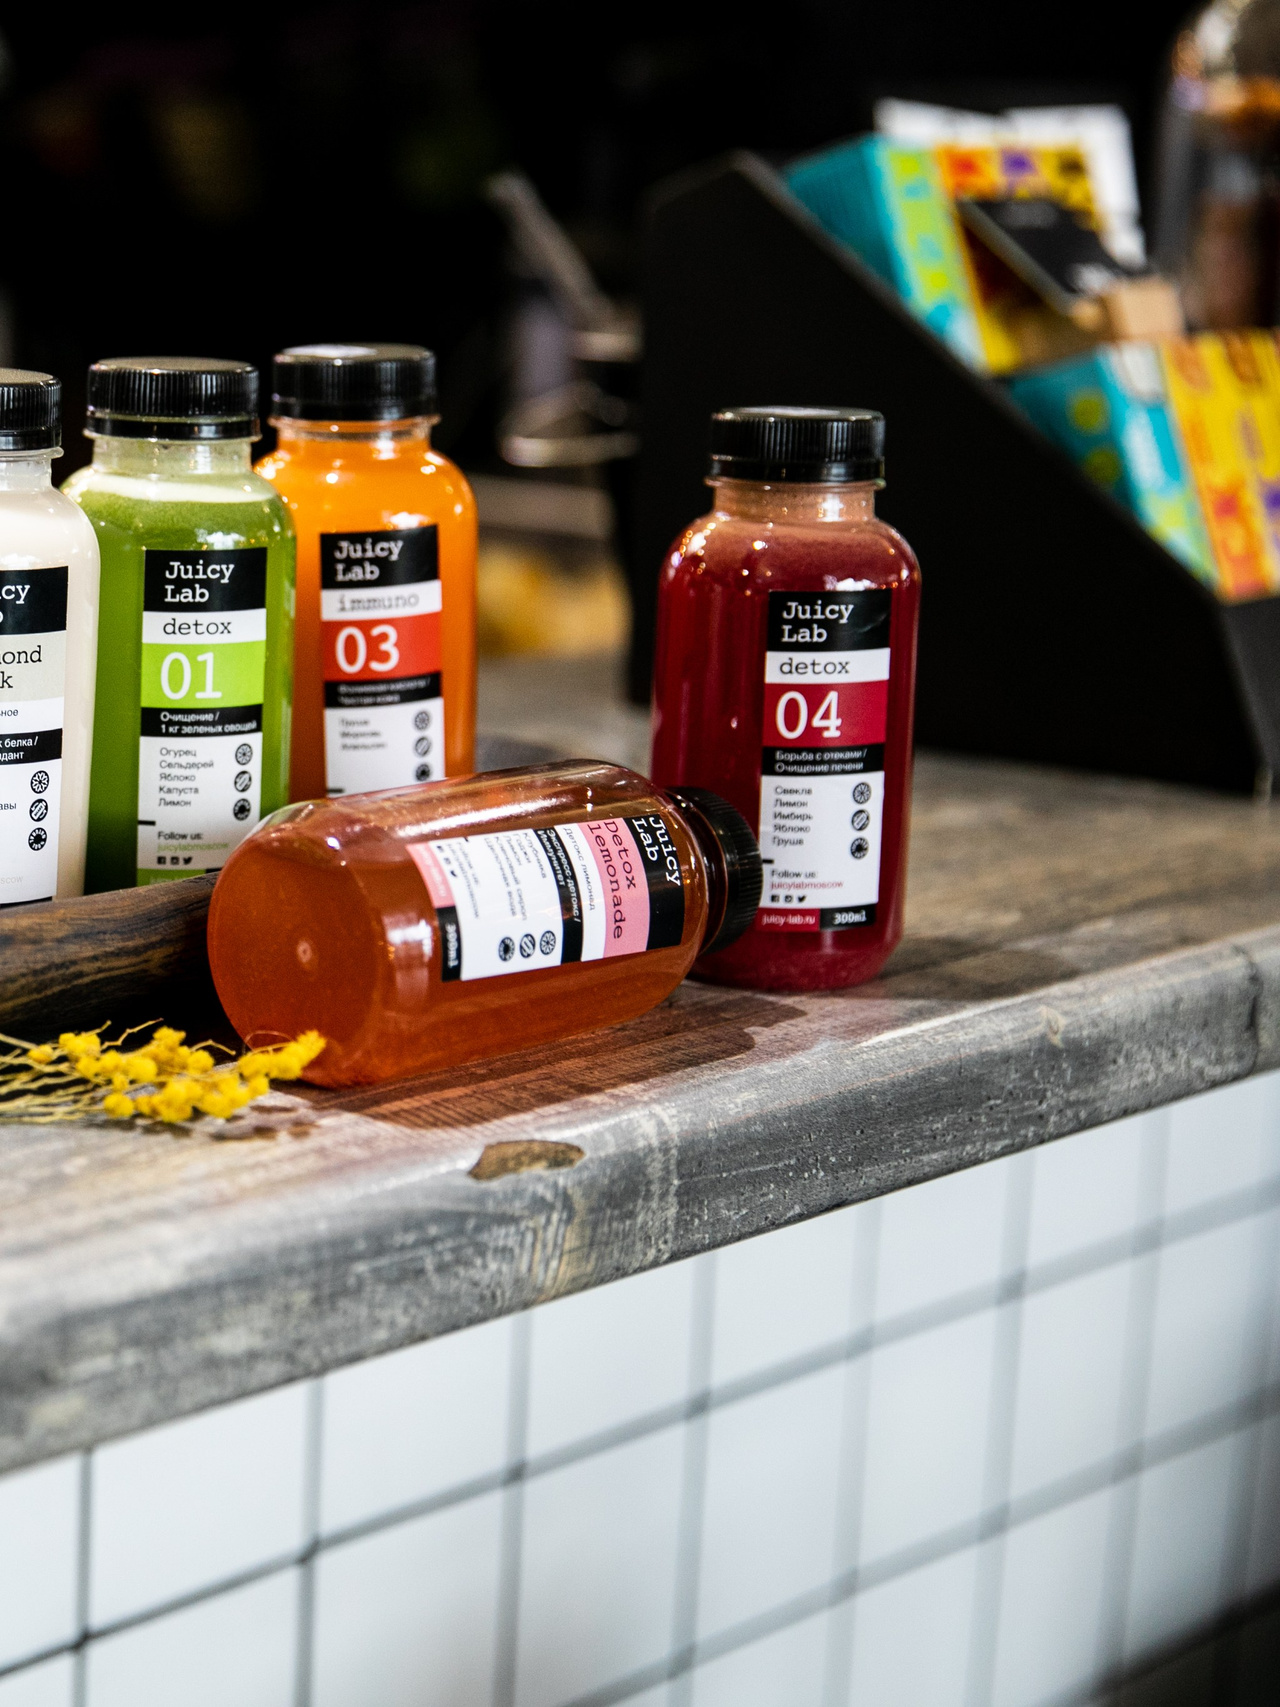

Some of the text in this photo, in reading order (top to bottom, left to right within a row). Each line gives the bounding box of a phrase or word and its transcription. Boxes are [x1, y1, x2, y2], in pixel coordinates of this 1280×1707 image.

[334, 537, 404, 561] Juicy
[165, 559, 235, 583] Juicy
[335, 561, 380, 582] Lab
[164, 584, 210, 603] Lab
[338, 593, 420, 612] immuno
[782, 600, 854, 624] Juicy
[163, 618, 232, 635] detox
[781, 624, 828, 642] Lab
[335, 624, 400, 674] 03
[780, 657, 850, 675] detox
[160, 652, 222, 700] 01
[775, 690, 842, 740] 04
[168, 725, 178, 734] кг
[181, 724, 223, 734] зеленых
[160, 748, 197, 759] Огурец
[776, 751, 814, 762] Борьба
[159, 760, 214, 770] Сельдерей
[775, 762, 864, 774] Очищение печени
[159, 773, 196, 782] Яблоко
[159, 786, 199, 795] Капуста
[158, 798, 191, 807] Лимон
[774, 799, 808, 808] Лимон
[158, 831, 188, 840] Follow
[773, 824, 810, 833] Яблоко
[632, 818, 659, 862] Lab
[537, 830, 566, 886] Иммунитет
[604, 820, 637, 890] Detox
[650, 816, 682, 886] Juicy
[563, 827, 596, 911] Детокс лимонад
[587, 823, 626, 939] lemonade
[833, 910, 867, 925] 300ml
